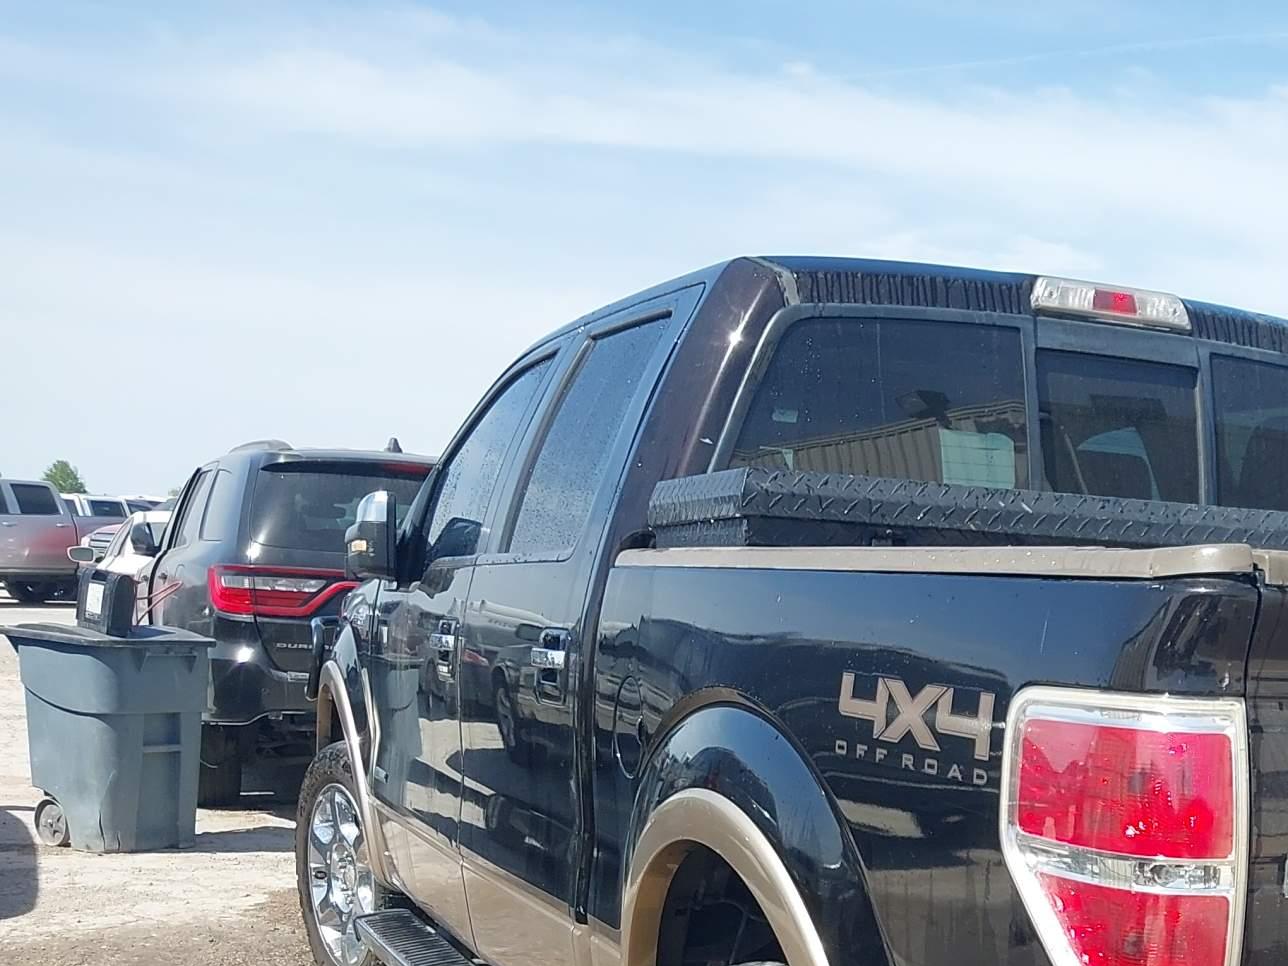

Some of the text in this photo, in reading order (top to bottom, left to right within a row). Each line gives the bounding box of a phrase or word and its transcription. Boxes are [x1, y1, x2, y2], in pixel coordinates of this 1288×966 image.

[838, 672, 996, 761] 4X4
[835, 740, 988, 786] OFF ROAD
